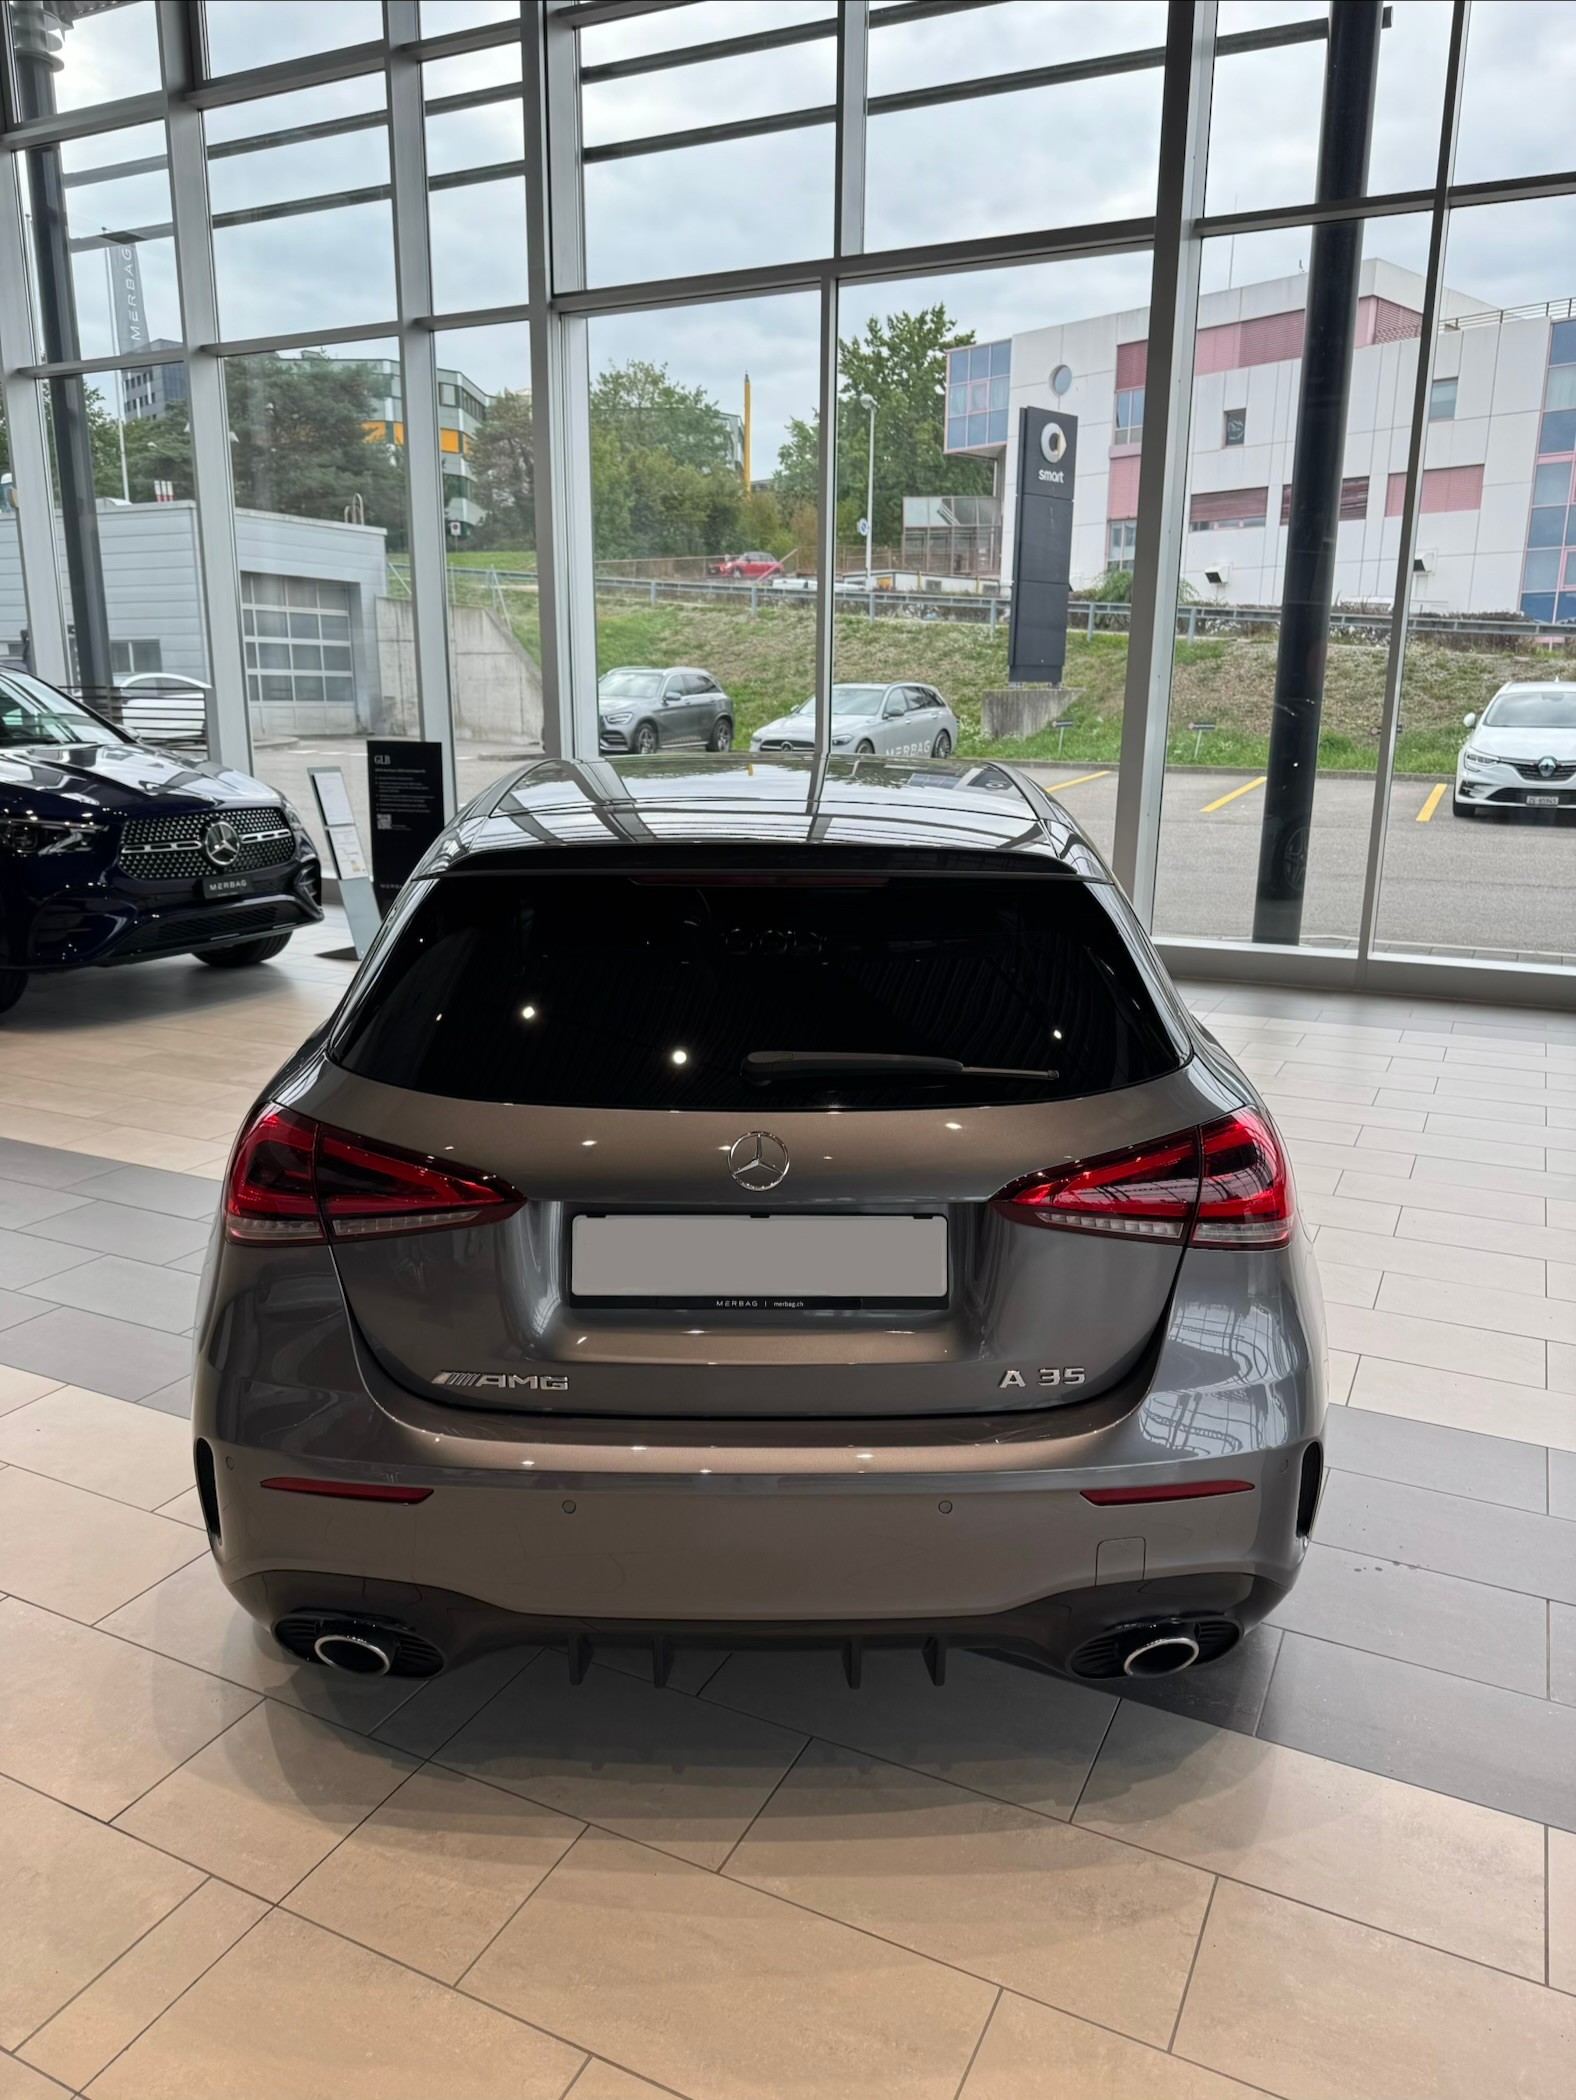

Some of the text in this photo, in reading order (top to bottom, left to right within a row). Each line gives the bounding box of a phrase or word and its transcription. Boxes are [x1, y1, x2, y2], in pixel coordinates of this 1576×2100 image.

[122, 248, 142, 341] MERBAG
[1038, 469, 1065, 484] smart
[374, 755, 391, 765] GLB
[209, 879, 247, 891] MERBAG
[999, 1367, 1086, 1388] A 35
